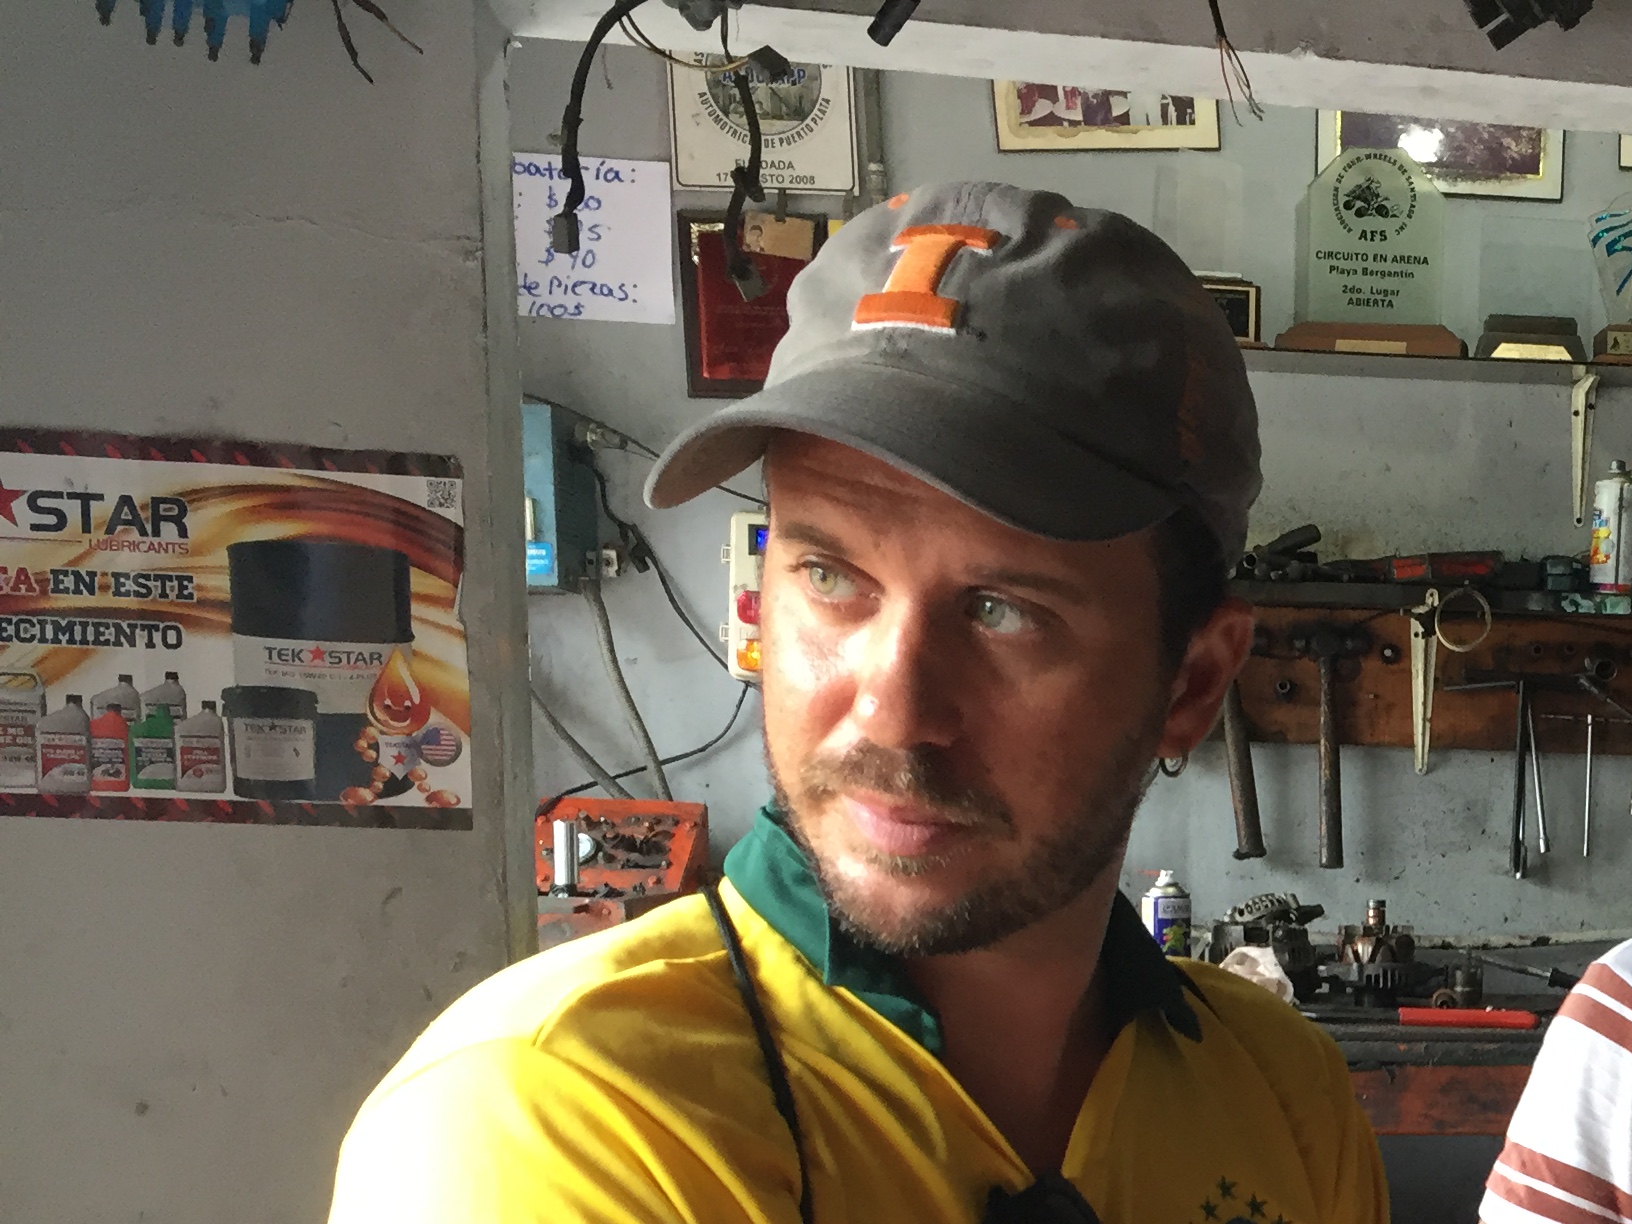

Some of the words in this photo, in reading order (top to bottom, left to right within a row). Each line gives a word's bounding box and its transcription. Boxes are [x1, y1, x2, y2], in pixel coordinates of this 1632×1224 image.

[778, 123, 814, 149] PUERTO
[813, 97, 832, 127] PLATA
[788, 175, 816, 185] 2008
[1358, 229, 1388, 242] AFS
[1315, 250, 1369, 262] CIRCUITO
[1372, 253, 1388, 263] EN
[1391, 255, 1430, 265] ARENA
[851, 224, 1003, 335] I
[1328, 265, 1358, 278] Playa
[1369, 286, 1400, 297] Lugar
[1347, 298, 1394, 309] ABIERTA
[26, 489, 189, 539] STAR
[88, 538, 190, 555] LUBRICANTS
[50, 568, 98, 597] EN
[110, 571, 195, 601] ESTE
[263, 646, 305, 664] TEK
[327, 650, 384, 666] STAR
